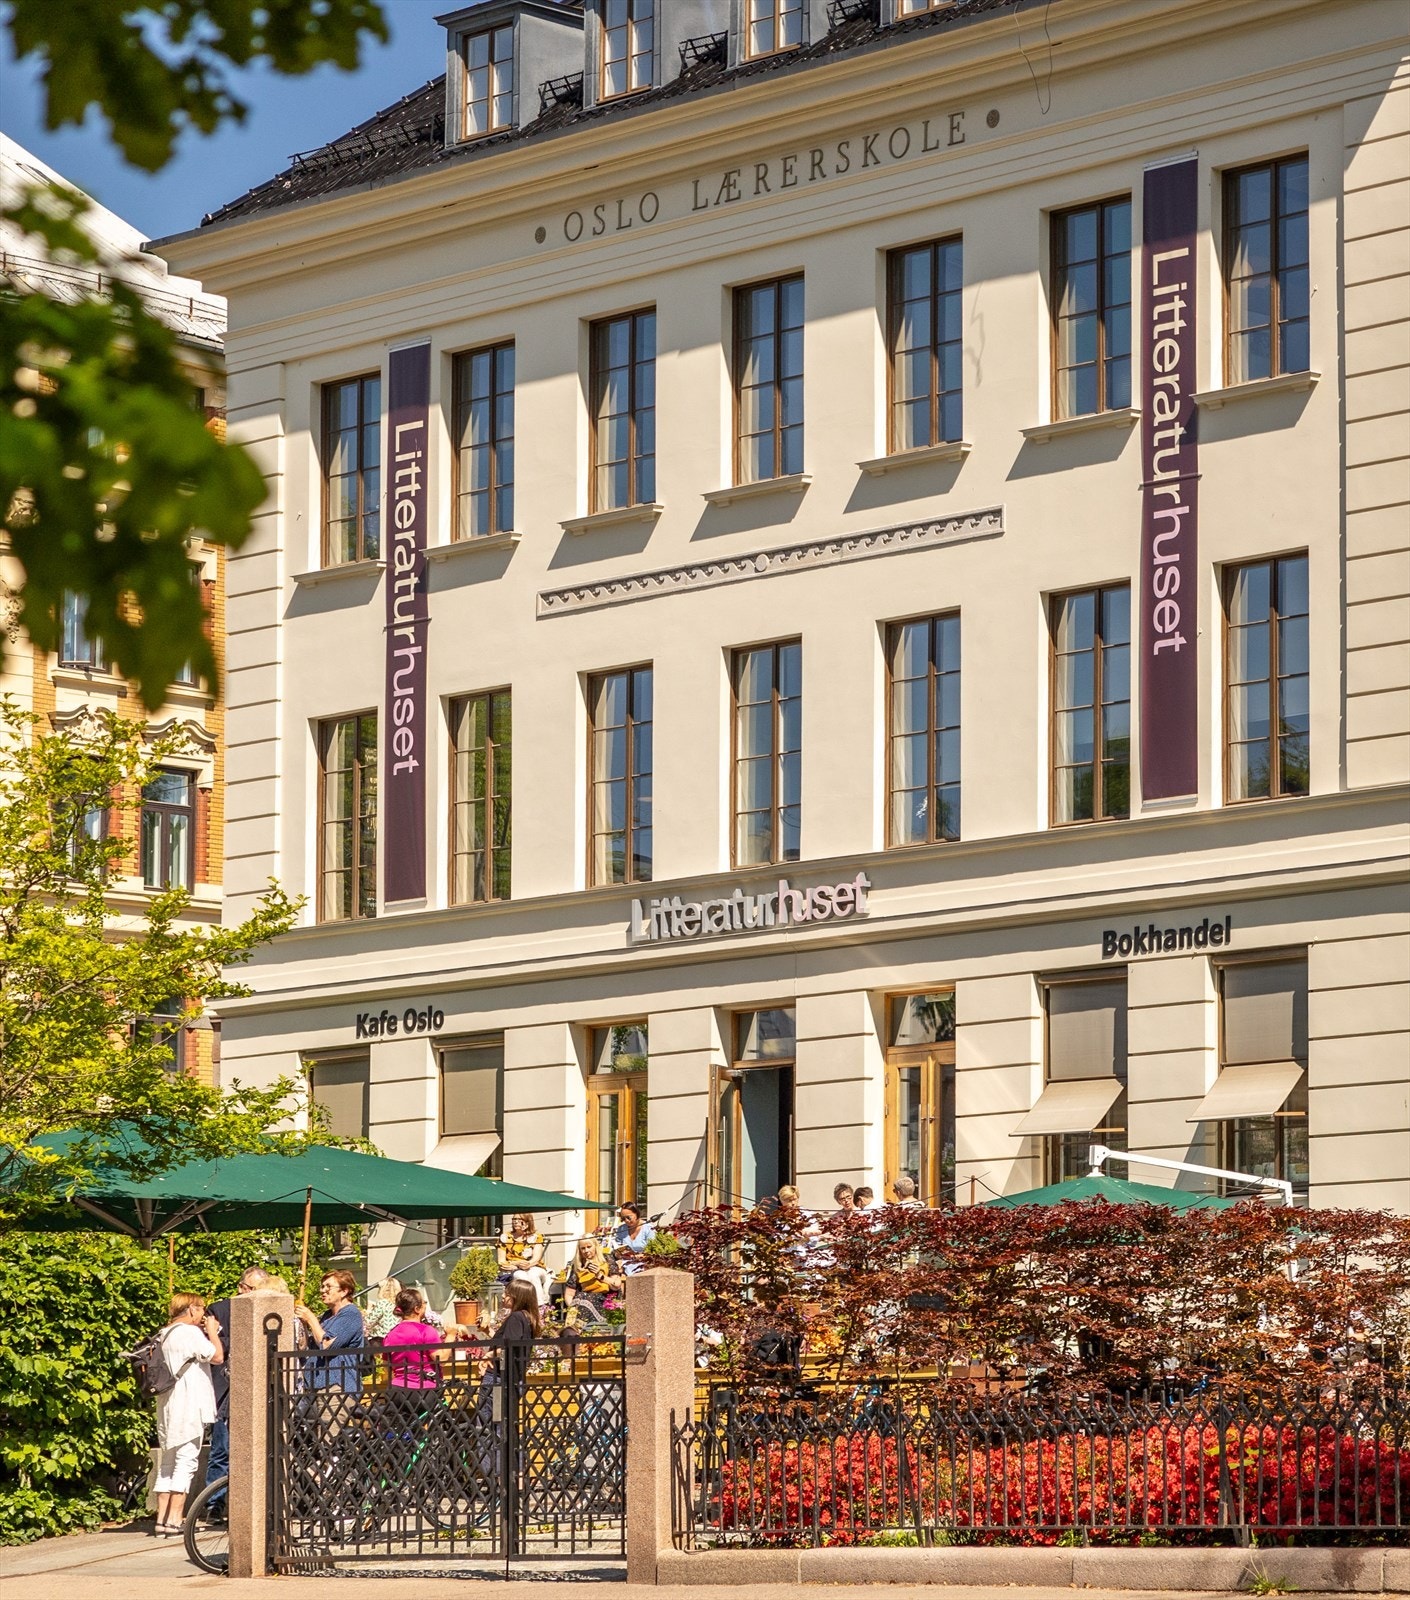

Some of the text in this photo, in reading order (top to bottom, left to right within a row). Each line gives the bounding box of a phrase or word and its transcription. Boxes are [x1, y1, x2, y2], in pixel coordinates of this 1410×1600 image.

[563, 111, 966, 242] OSLO LÆRERSKOLE
[1151, 247, 1190, 656] Litteraturhuset
[392, 420, 425, 776] Litteraturhuset
[631, 872, 871, 942] Litteraturhuset
[1102, 915, 1231, 958] Bokhandel
[356, 1005, 445, 1039] Kafe Oslo
